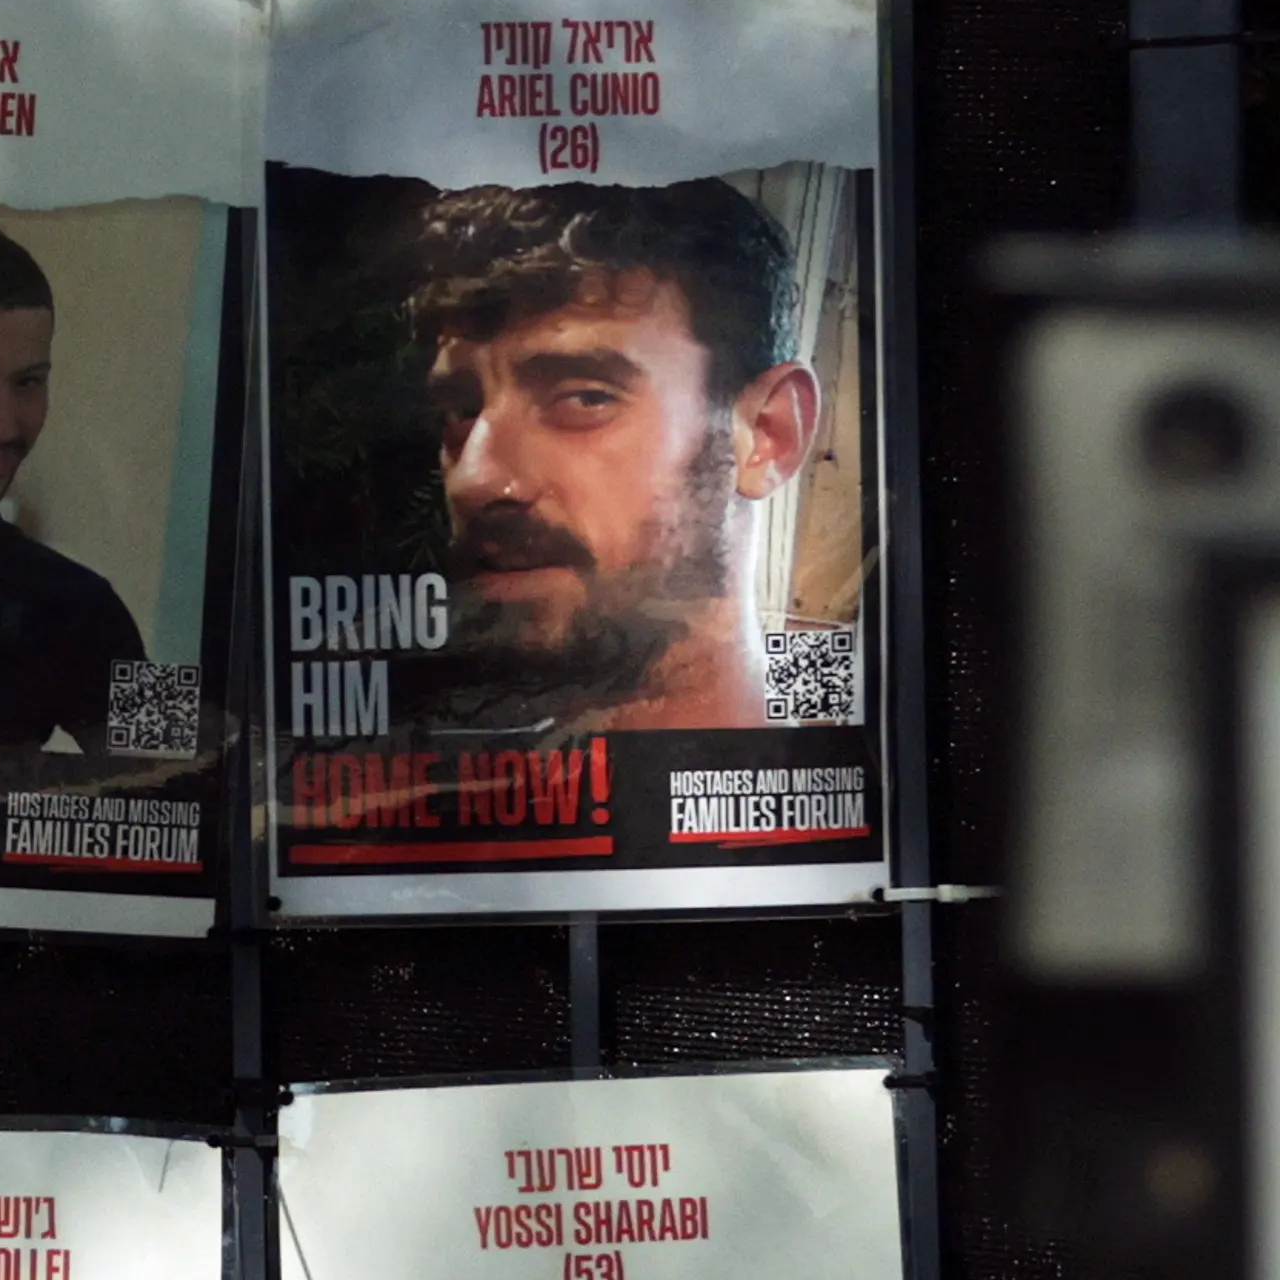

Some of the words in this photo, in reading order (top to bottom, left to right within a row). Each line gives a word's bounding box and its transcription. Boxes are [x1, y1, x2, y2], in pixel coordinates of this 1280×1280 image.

[482, 23, 552, 67] קוניו
[562, 19, 654, 63] אריאל
[477, 75, 560, 117] ARIEL
[571, 73, 659, 116] CUNIO
[540, 124, 598, 173] (26)
[670, 770, 752, 797] HOSTAGES
[754, 769, 788, 795] AND
[791, 767, 864, 794] MISSING
[8, 792, 89, 822] HOSTAGES
[91, 796, 125, 824] AND
[128, 798, 200, 827] MISSING
[671, 794, 774, 833] FAMILIES
[781, 792, 864, 831] FORUM
[5, 819, 109, 860] FAMILIES
[116, 824, 199, 864] FORUM
[504, 1148, 603, 1193] שרעבי
[613, 1145, 670, 1188] יוסי
[476, 1204, 563, 1249] YOSSI
[573, 1198, 709, 1245] SHARABI
